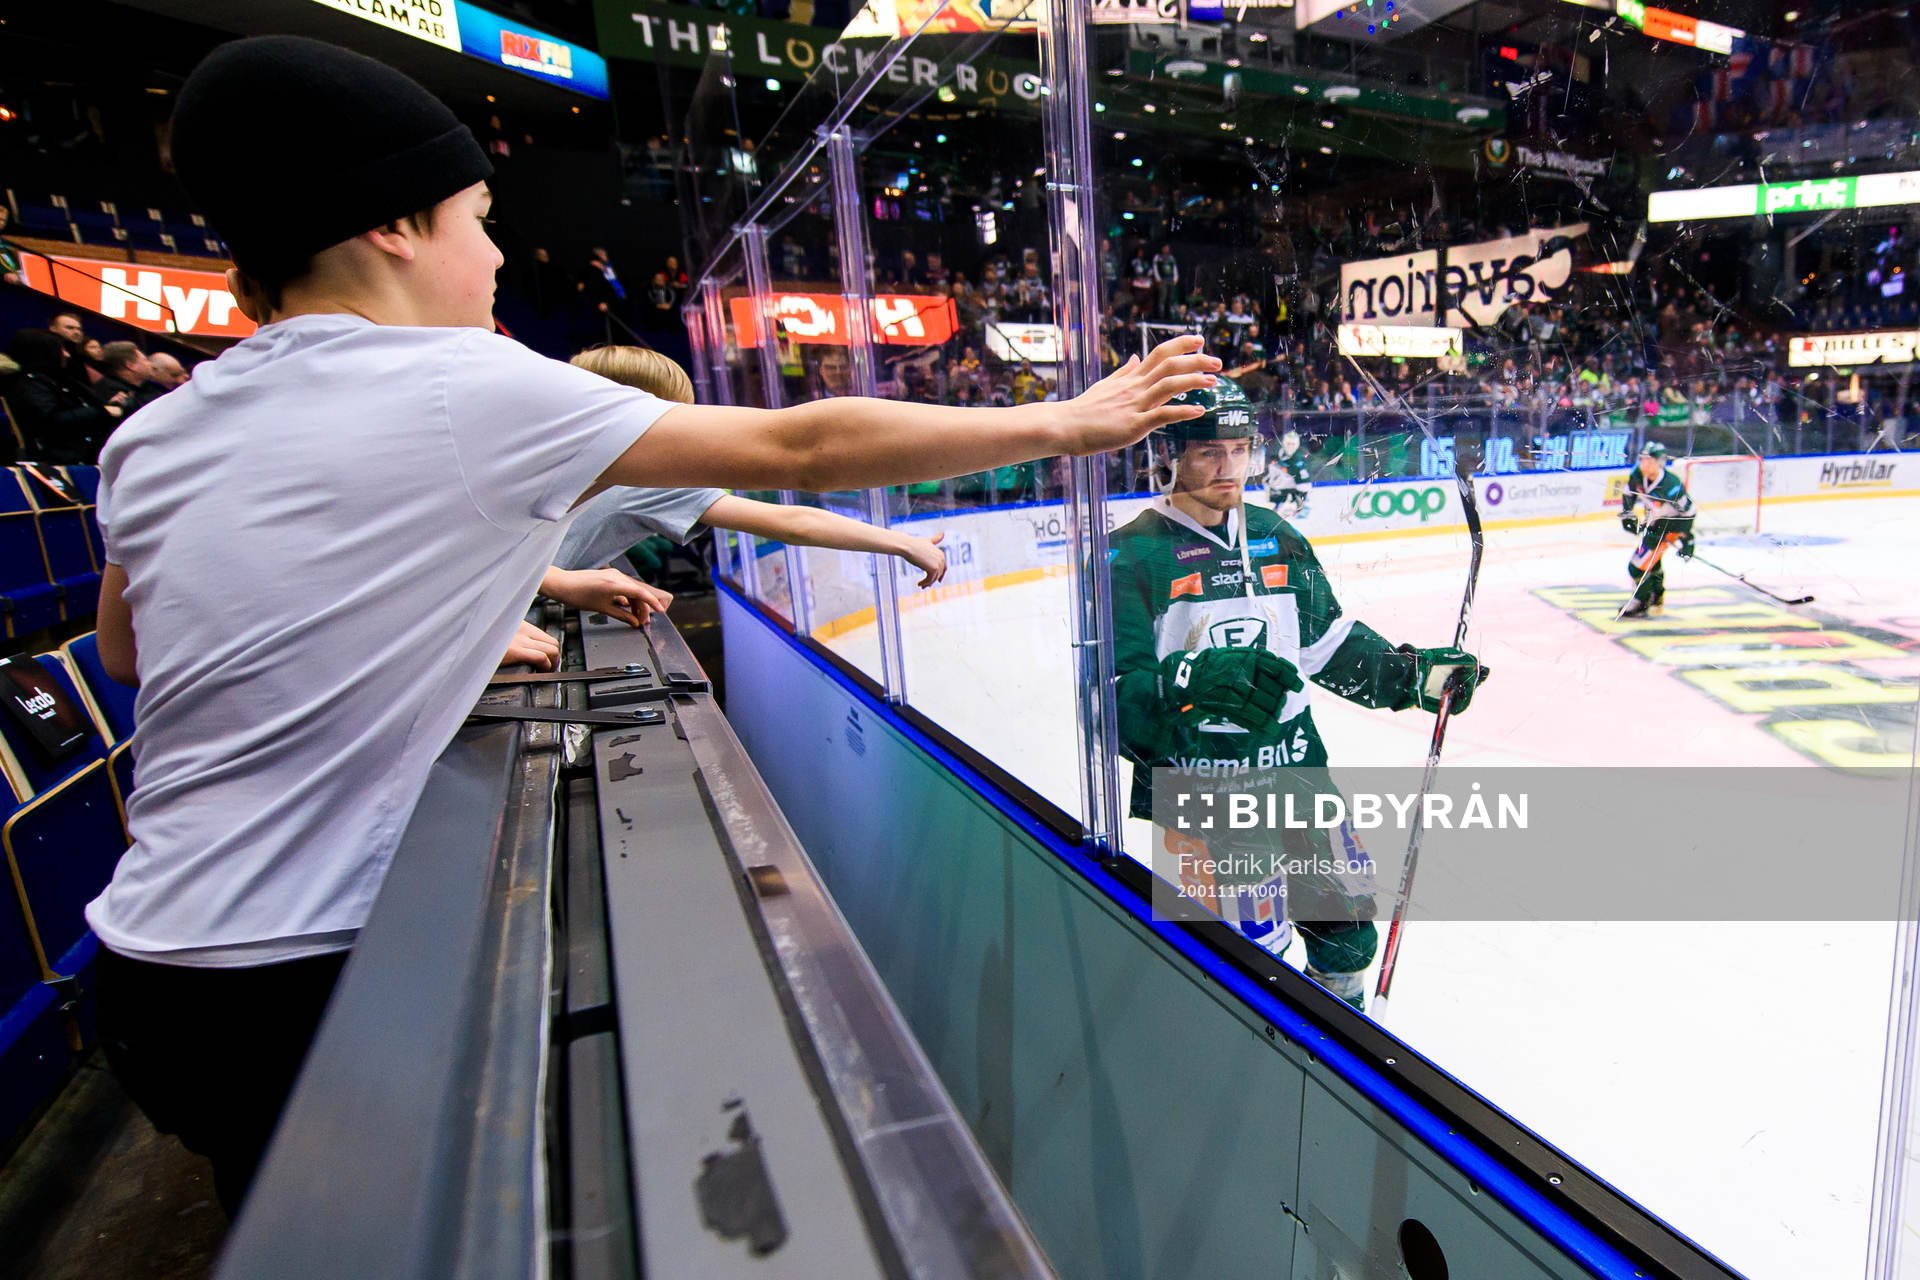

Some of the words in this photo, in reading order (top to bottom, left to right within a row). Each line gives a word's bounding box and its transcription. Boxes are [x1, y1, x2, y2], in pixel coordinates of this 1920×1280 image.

[757, 32, 938, 87] LOCKER
[1820, 459, 1895, 486] Hyrbilar
[1352, 487, 1446, 521] coop
